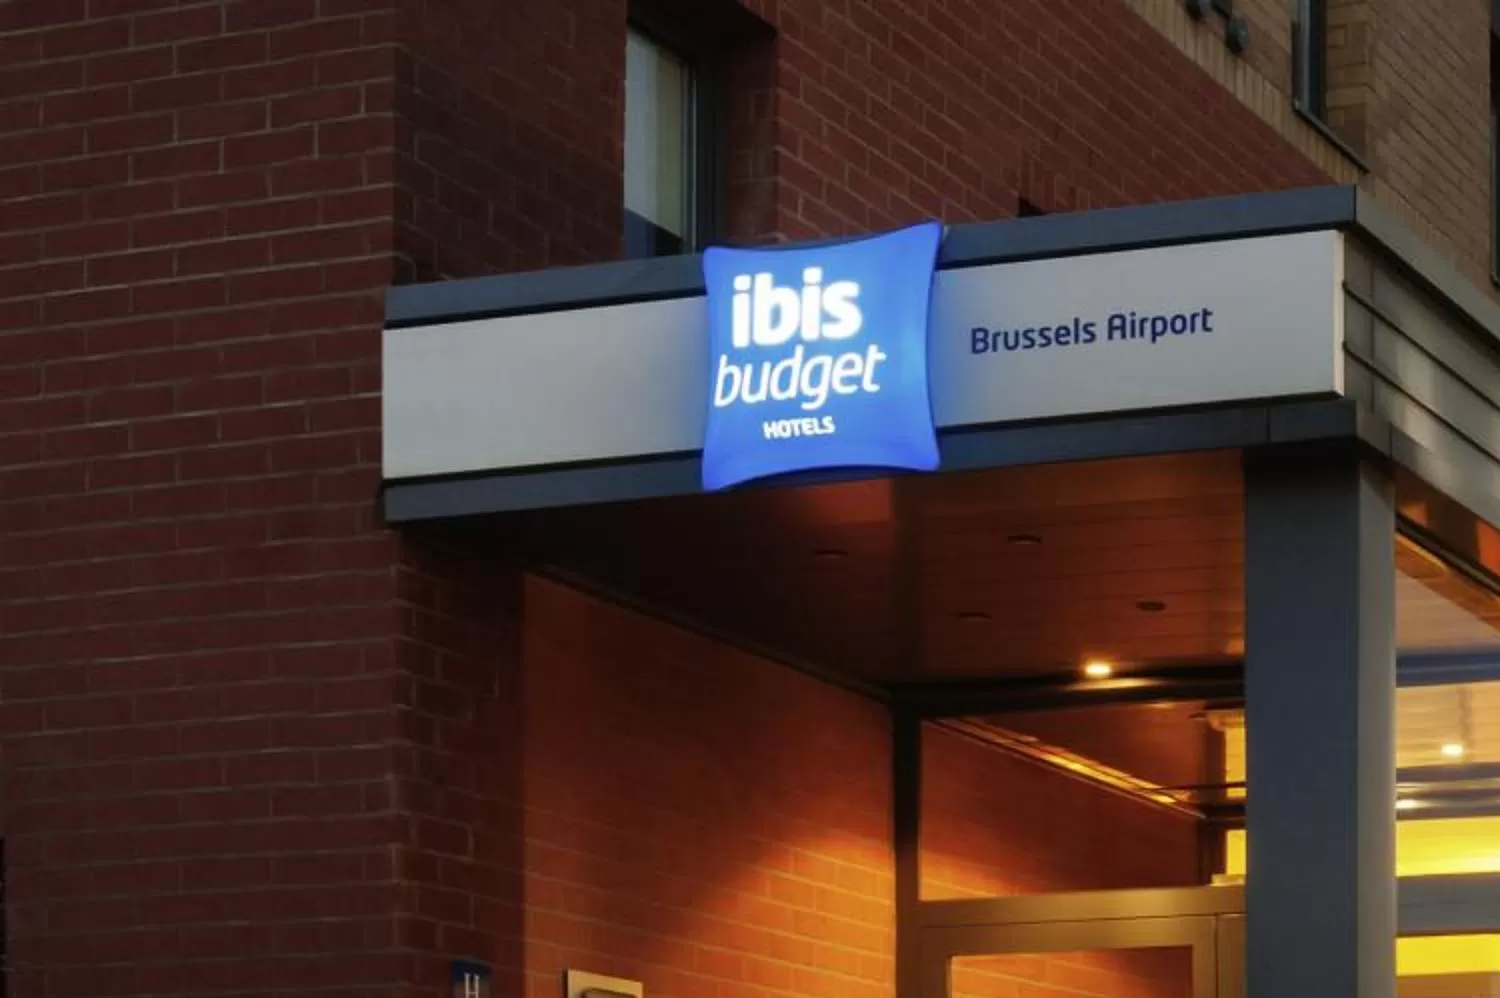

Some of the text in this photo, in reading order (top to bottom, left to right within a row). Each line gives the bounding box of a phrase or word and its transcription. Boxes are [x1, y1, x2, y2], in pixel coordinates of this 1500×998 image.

[732, 266, 862, 348] ibis
[970, 307, 1213, 354] Brussels Airport
[713, 345, 886, 410] budget
[763, 416, 835, 439] HOTELS
